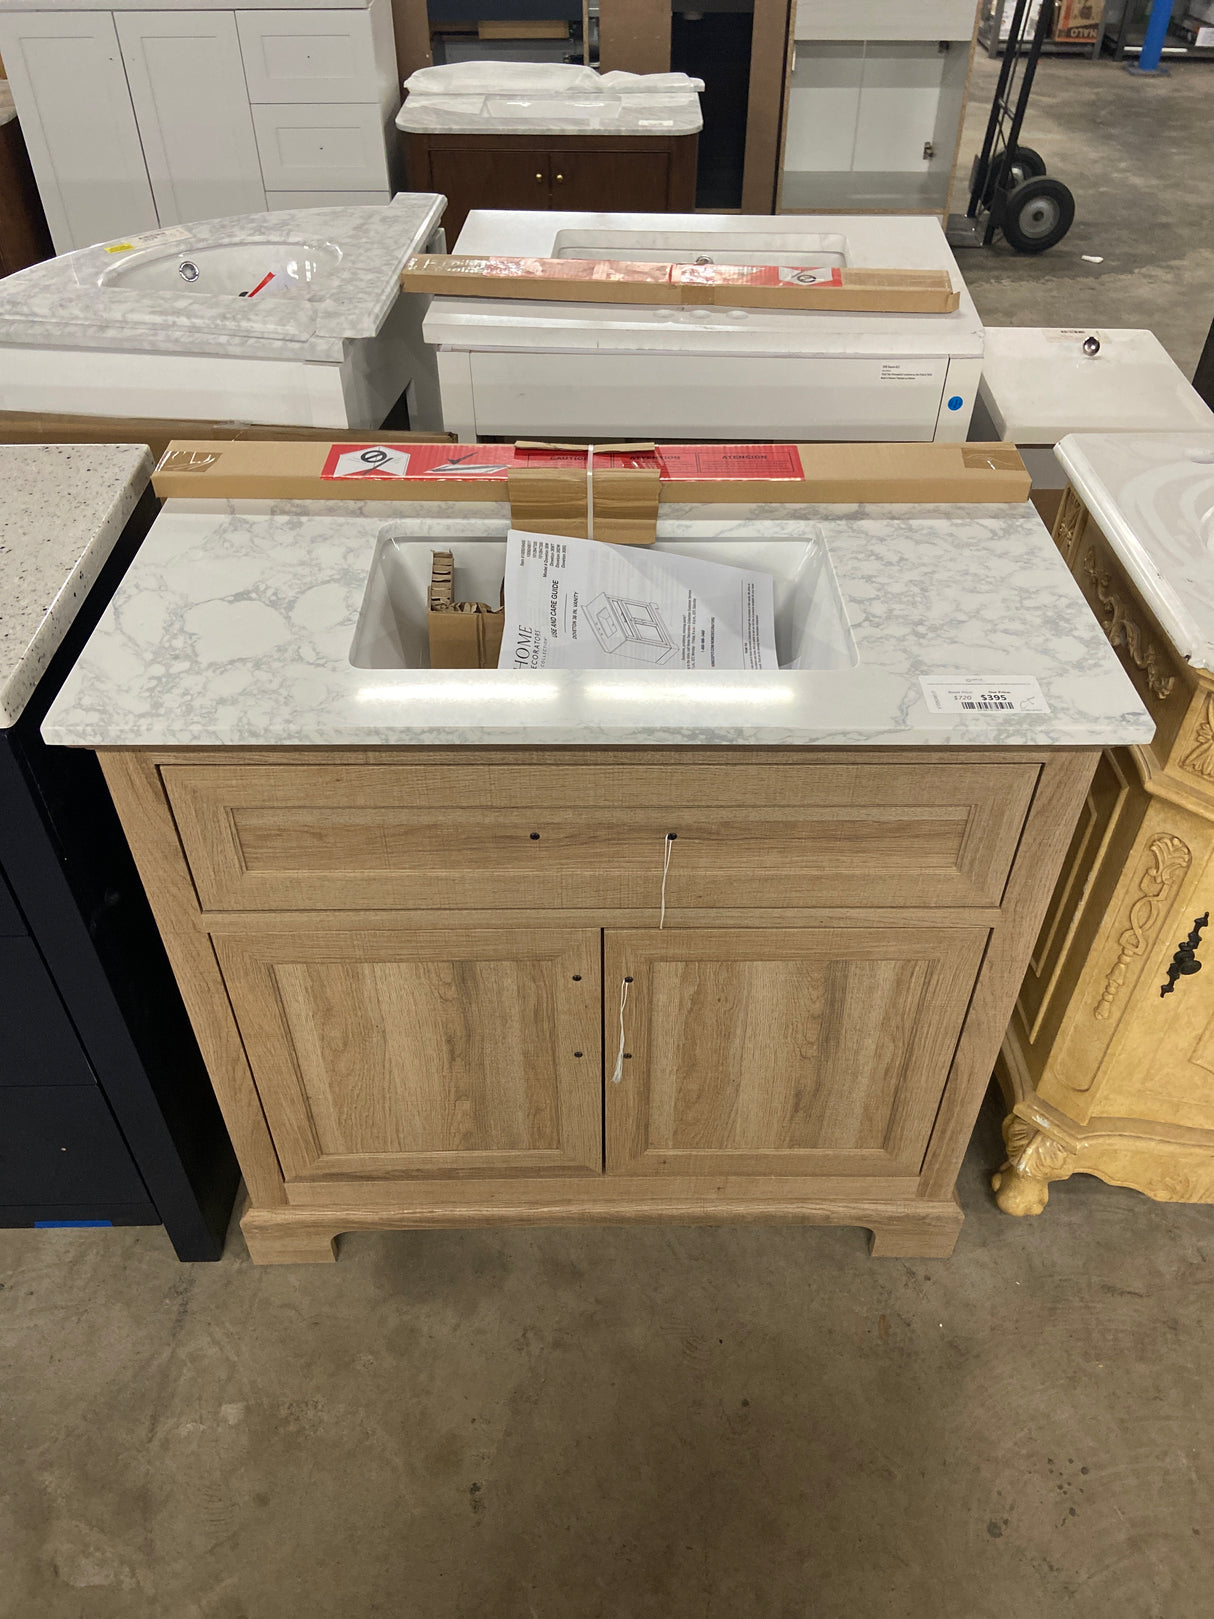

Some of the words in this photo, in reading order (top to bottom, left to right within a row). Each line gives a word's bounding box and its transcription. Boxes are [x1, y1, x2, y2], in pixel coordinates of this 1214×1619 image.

[1070, 28, 1097, 38] HALO
[551, 580, 559, 600] GUIDE
[550, 600, 558, 616] CARE
[513, 625, 532, 669] HOME
[530, 630, 541, 669] ECORATORS
